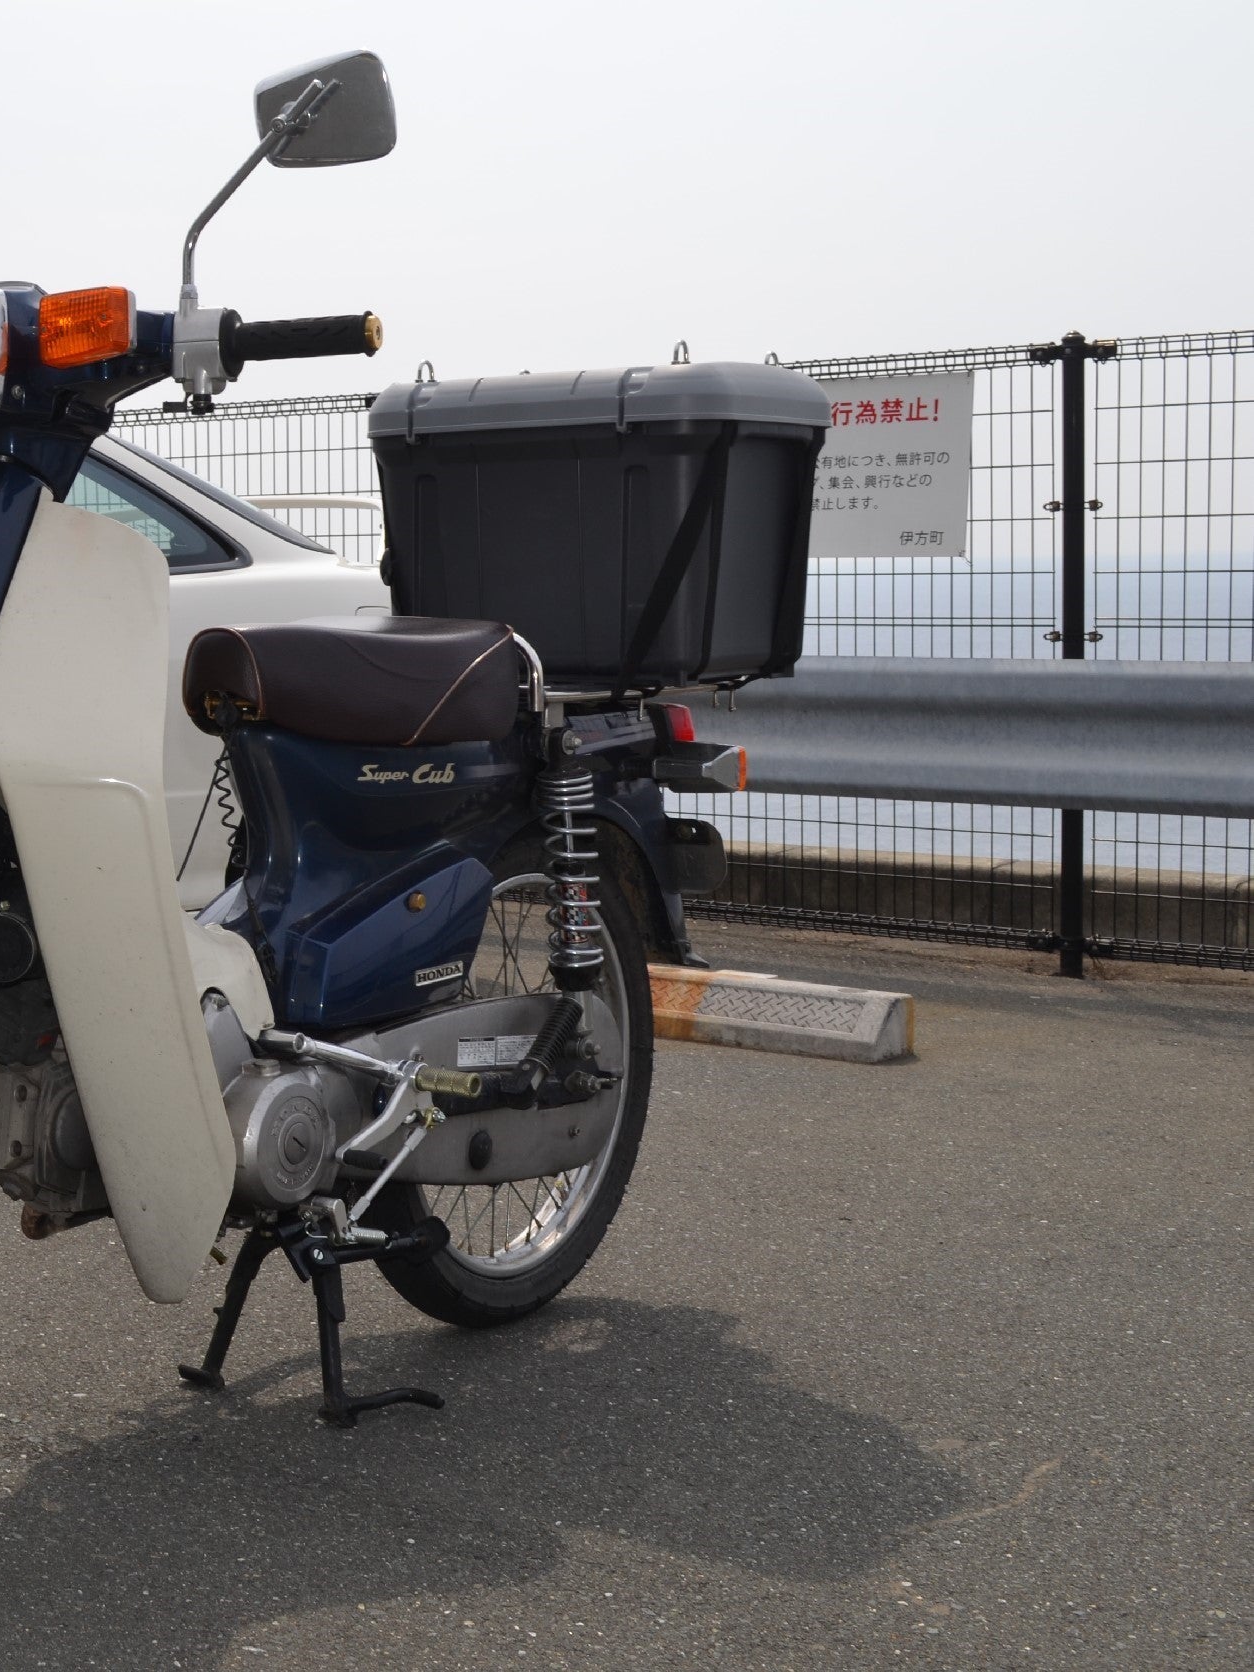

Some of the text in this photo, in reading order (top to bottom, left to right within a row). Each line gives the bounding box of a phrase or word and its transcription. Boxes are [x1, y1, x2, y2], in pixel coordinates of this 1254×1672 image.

[900, 531, 944, 545] 伊方町
[357, 762, 456, 784] Super Cub
[417, 964, 461, 982] HONDA
